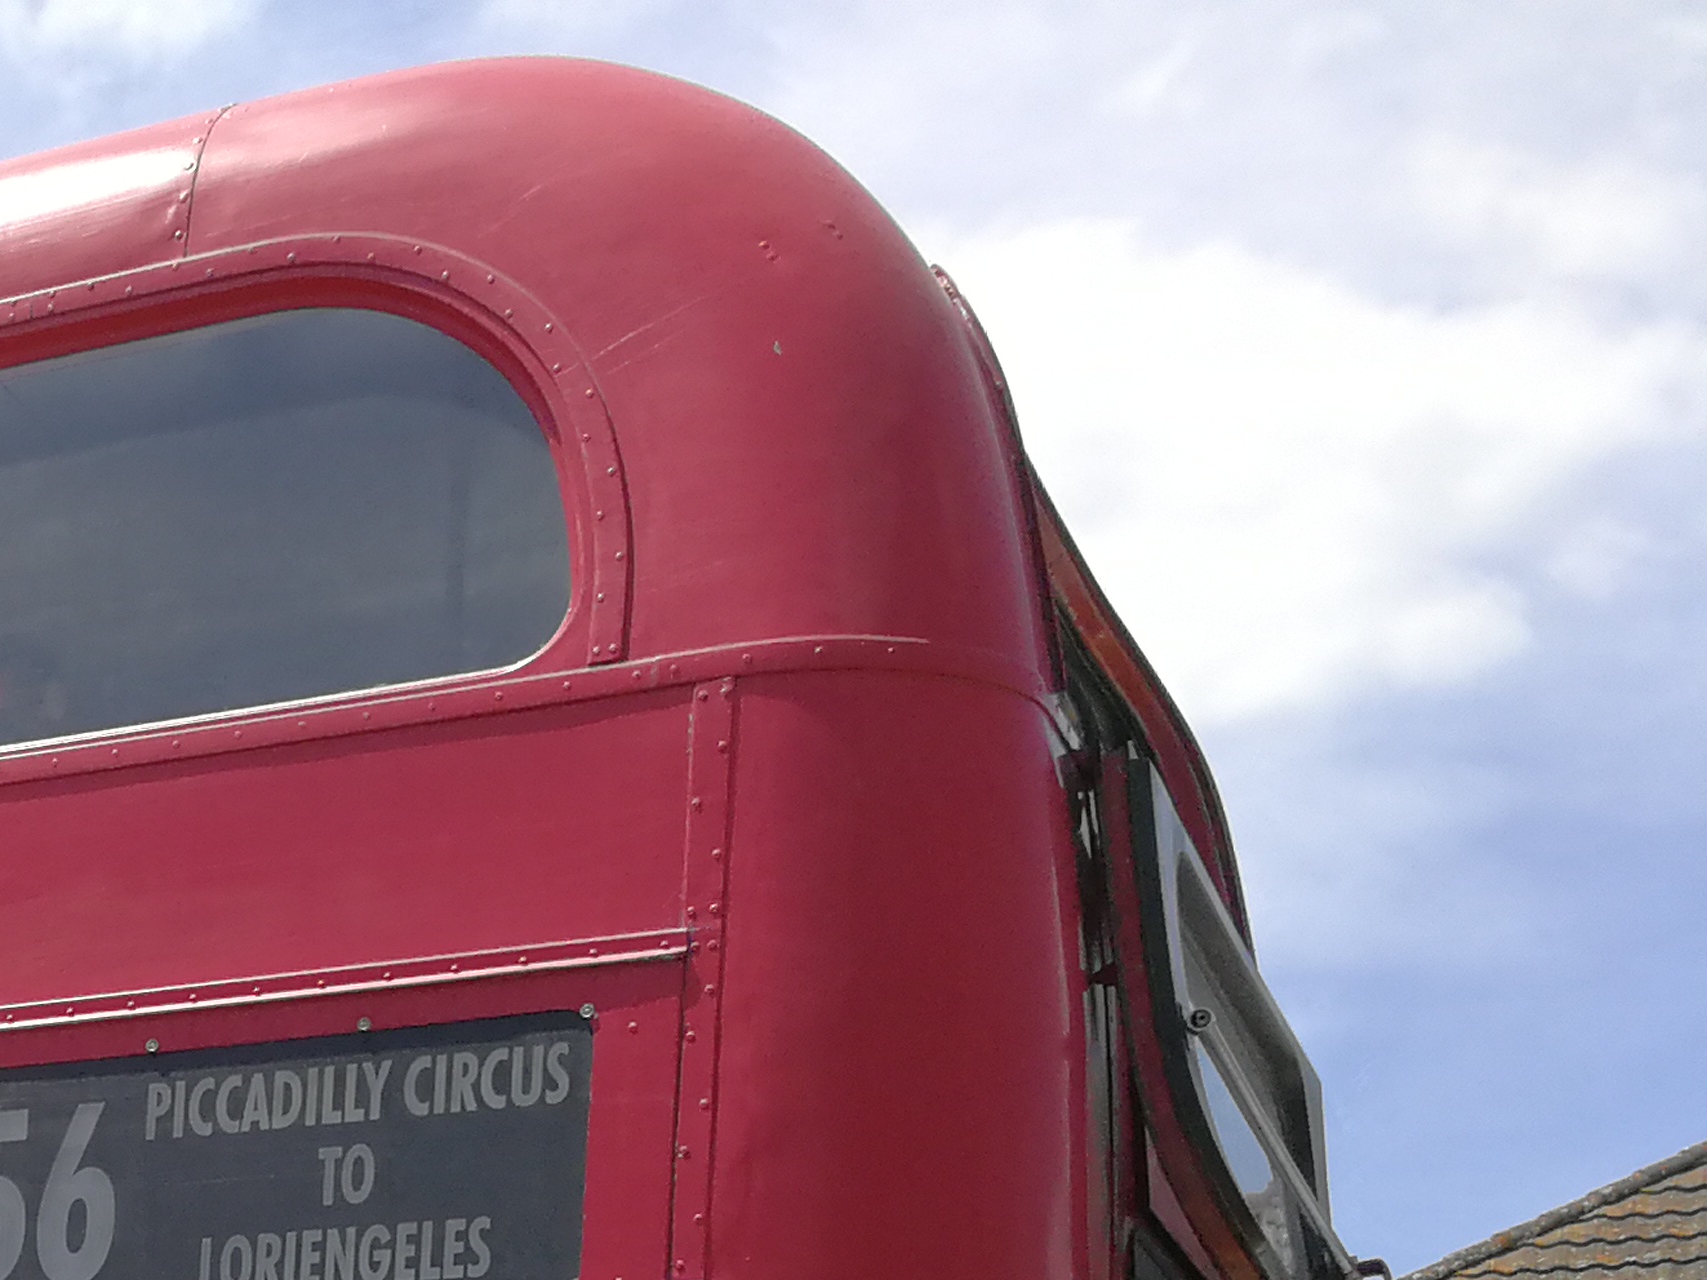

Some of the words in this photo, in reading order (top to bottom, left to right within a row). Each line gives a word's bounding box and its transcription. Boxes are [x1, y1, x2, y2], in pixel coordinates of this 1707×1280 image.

[144, 1059, 394, 1141] PICCADILLY
[403, 1041, 571, 1118] CIRCUS
[317, 1142, 376, 1207] TO
